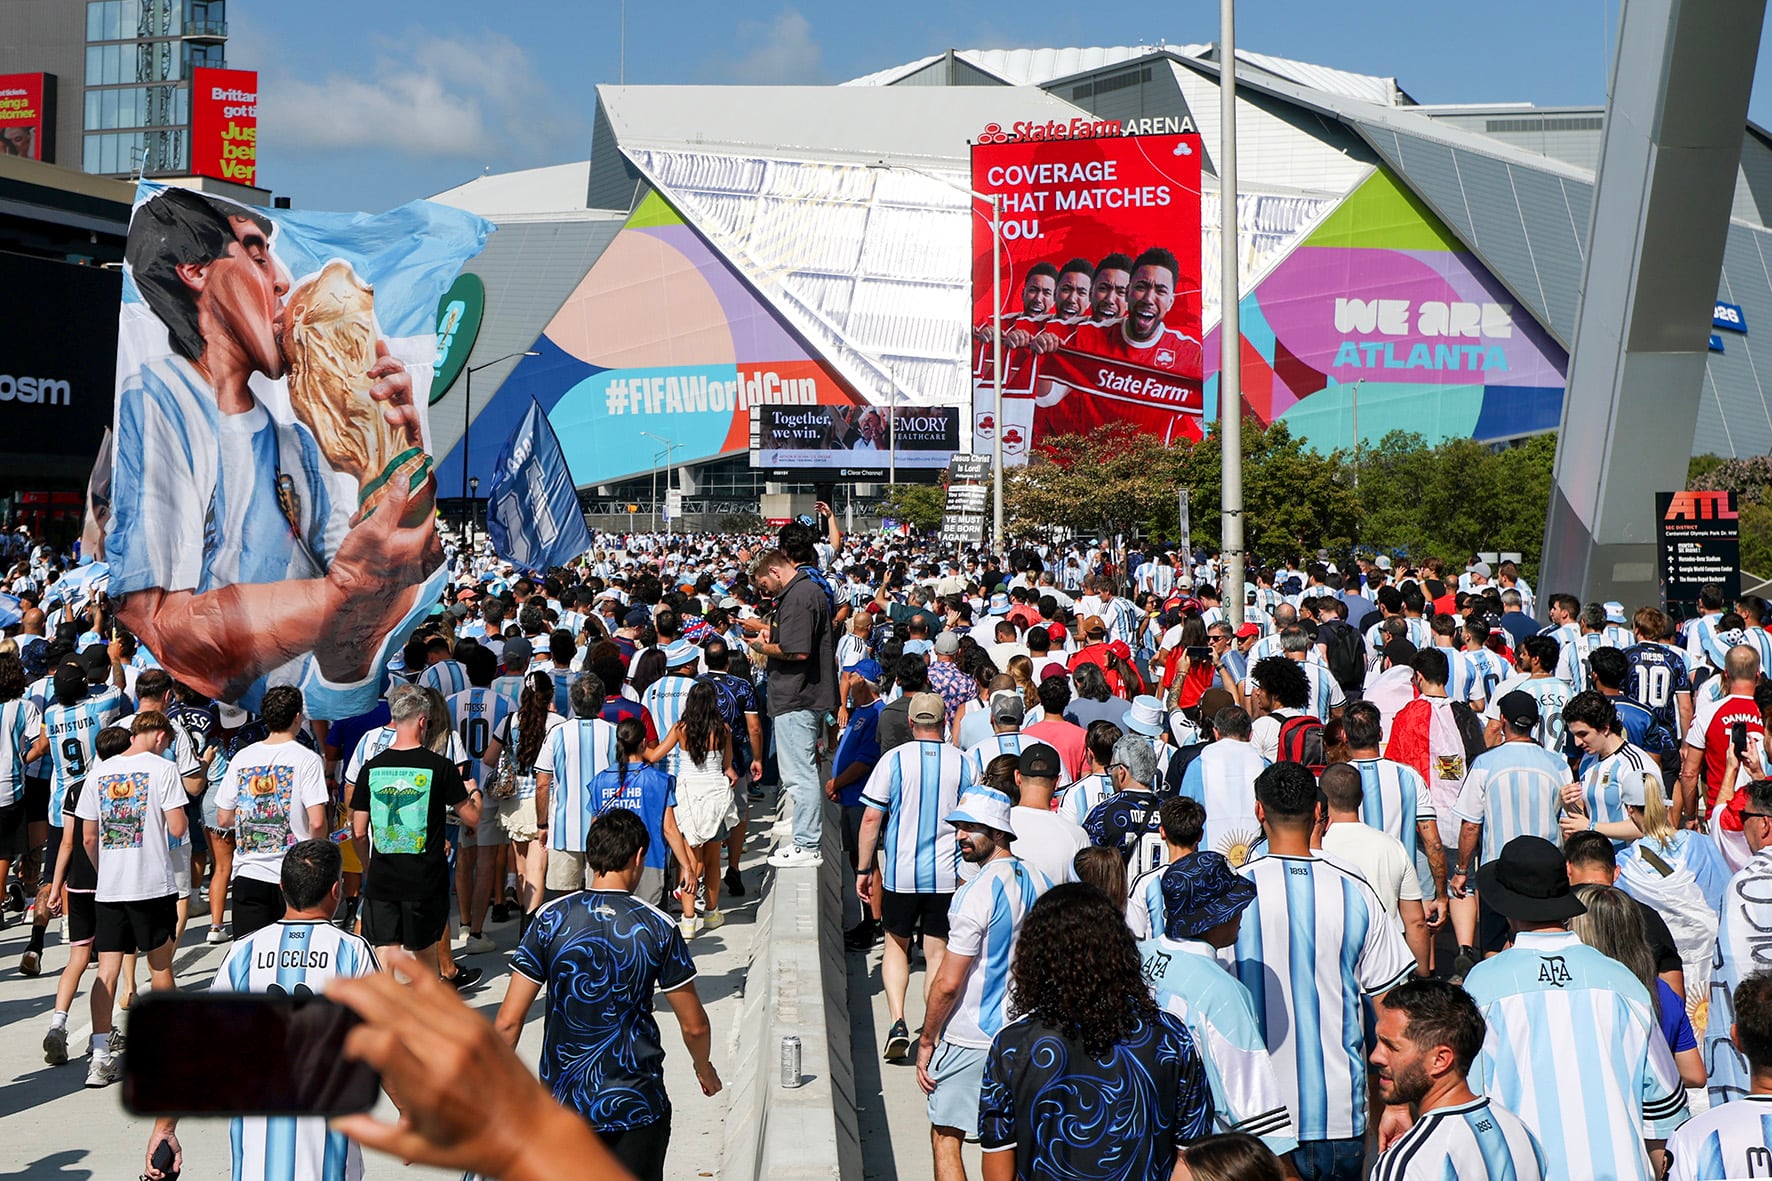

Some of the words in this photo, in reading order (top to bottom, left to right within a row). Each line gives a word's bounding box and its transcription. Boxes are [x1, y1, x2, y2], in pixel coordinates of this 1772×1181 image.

[224, 106, 247, 118] got
[221, 122, 256, 140] Jus
[1125, 116, 1194, 135] ARENA
[987, 160, 1118, 186] COVERAGE
[1055, 186, 1171, 210] MATCHES
[1334, 298, 1410, 336] WE
[1333, 341, 1509, 371] ATLANTA
[605, 371, 818, 416] #FIFAWorldCup
[772, 411, 832, 426] Together,
[772, 429, 790, 438] we
[792, 428, 820, 439] win.
[1664, 491, 1738, 519] ATL
[1641, 652, 1664, 662] MESSI
[1634, 664, 1671, 708] 10
[464, 702, 487, 713] MESSI
[49, 716, 95, 735] BATISTUTA
[170, 712, 210, 731] MESSI
[460, 718, 489, 759] 10
[62, 737, 86, 776] 9
[627, 787, 642, 798] HB
[1290, 867, 1308, 876] 1893
[289, 931, 305, 939] 1893
[257, 951, 275, 969] LO
[280, 950, 328, 969] CELSO
[1141, 950, 1172, 981] AFA
[1538, 956, 1572, 987] AFA
